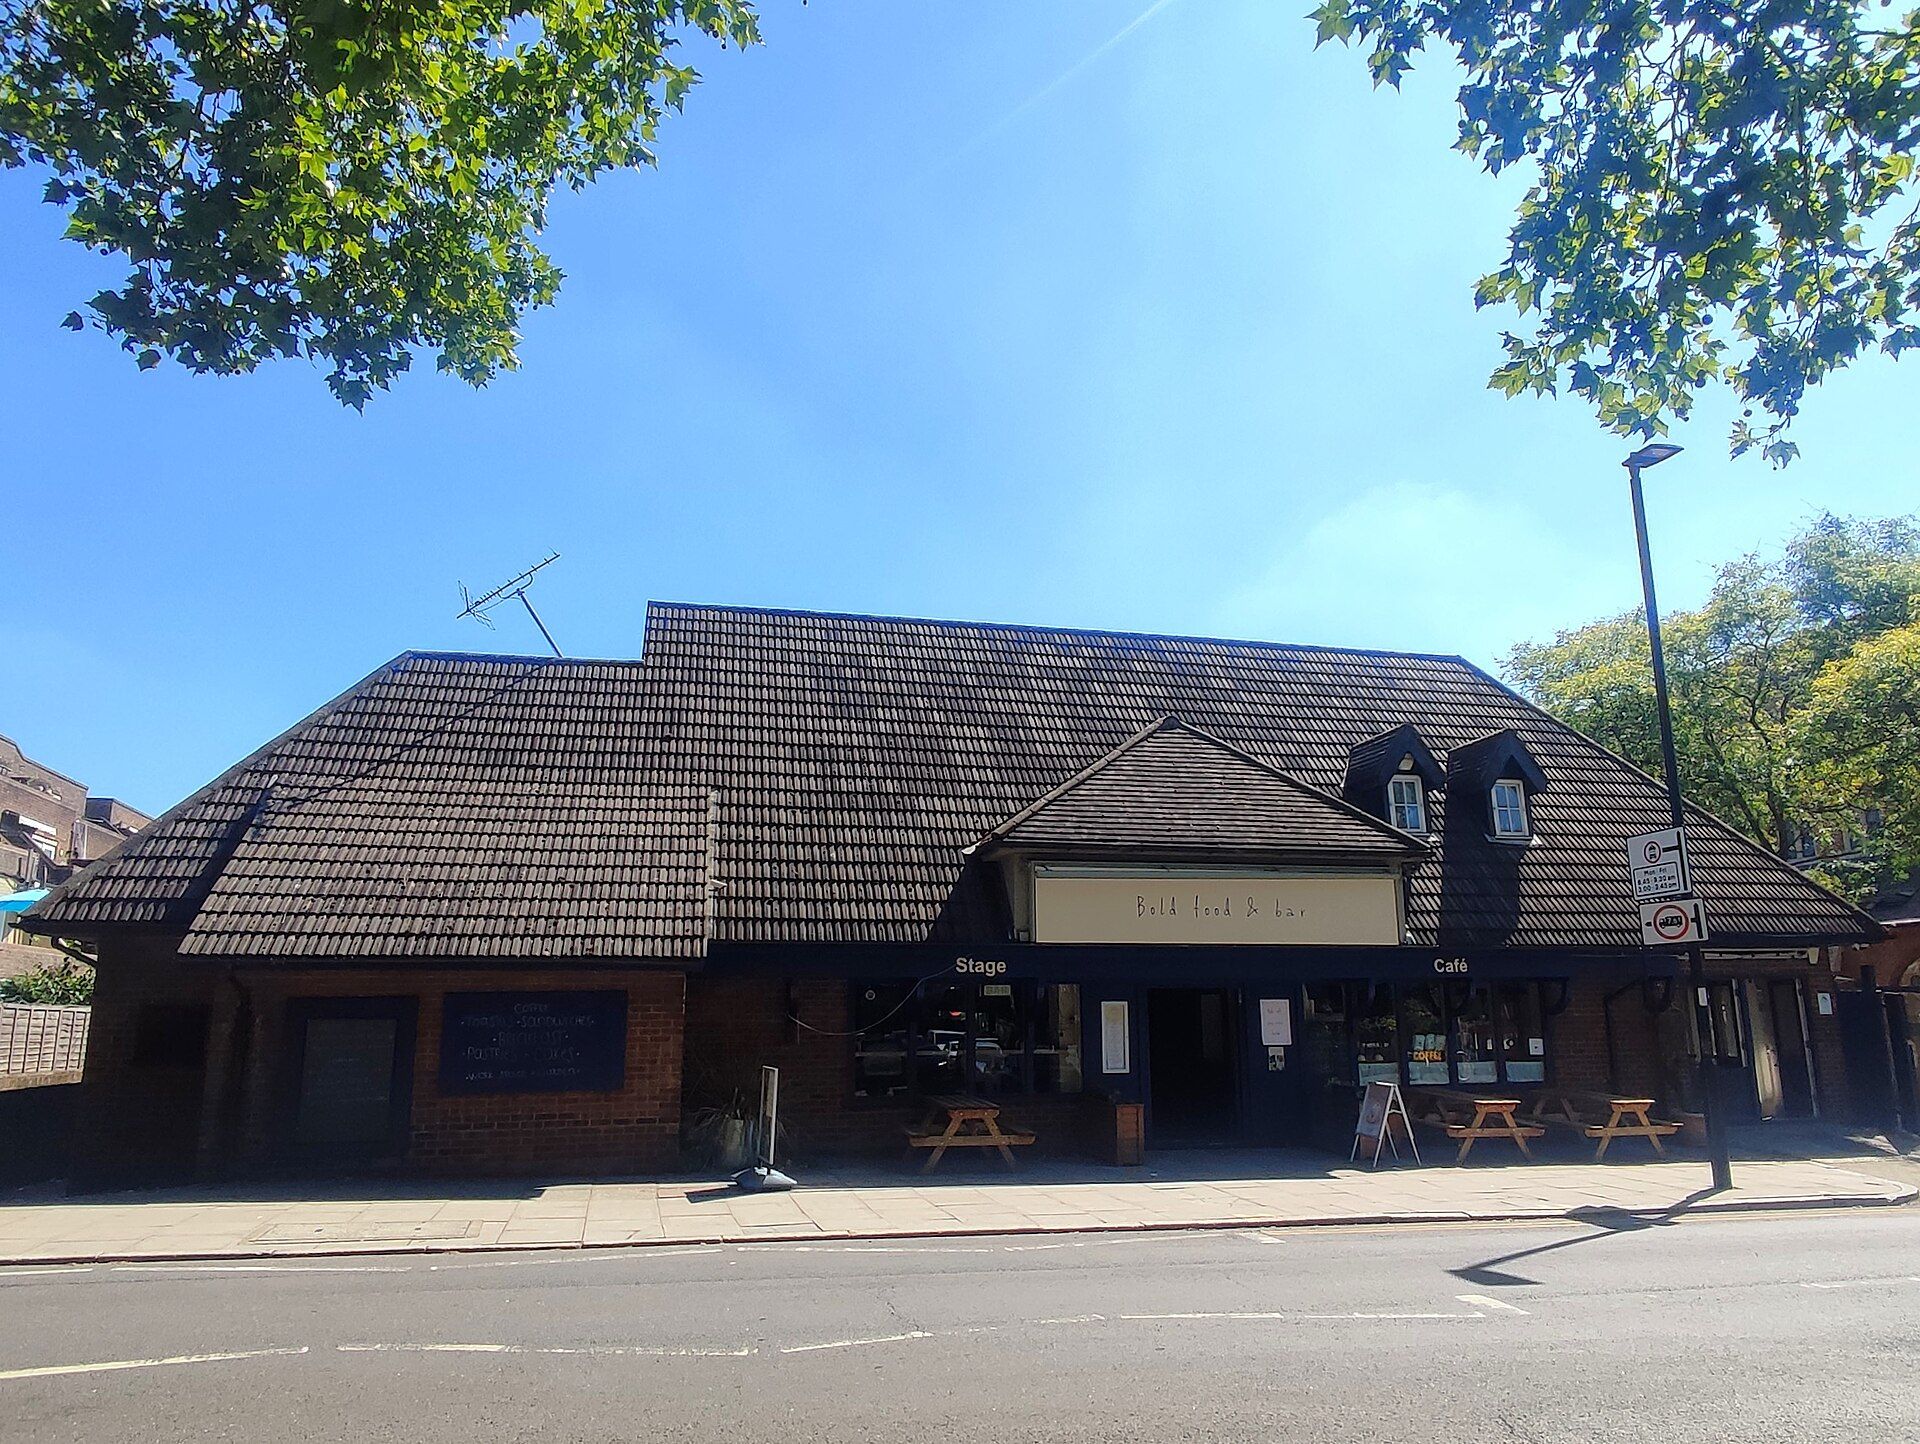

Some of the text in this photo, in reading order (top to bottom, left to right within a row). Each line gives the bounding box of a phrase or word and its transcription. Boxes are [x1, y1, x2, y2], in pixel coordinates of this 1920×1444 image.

[1137, 895, 1307, 918] Bold food & bar
[956, 957, 1007, 977] Stage
[1433, 957, 1468, 973] Café
